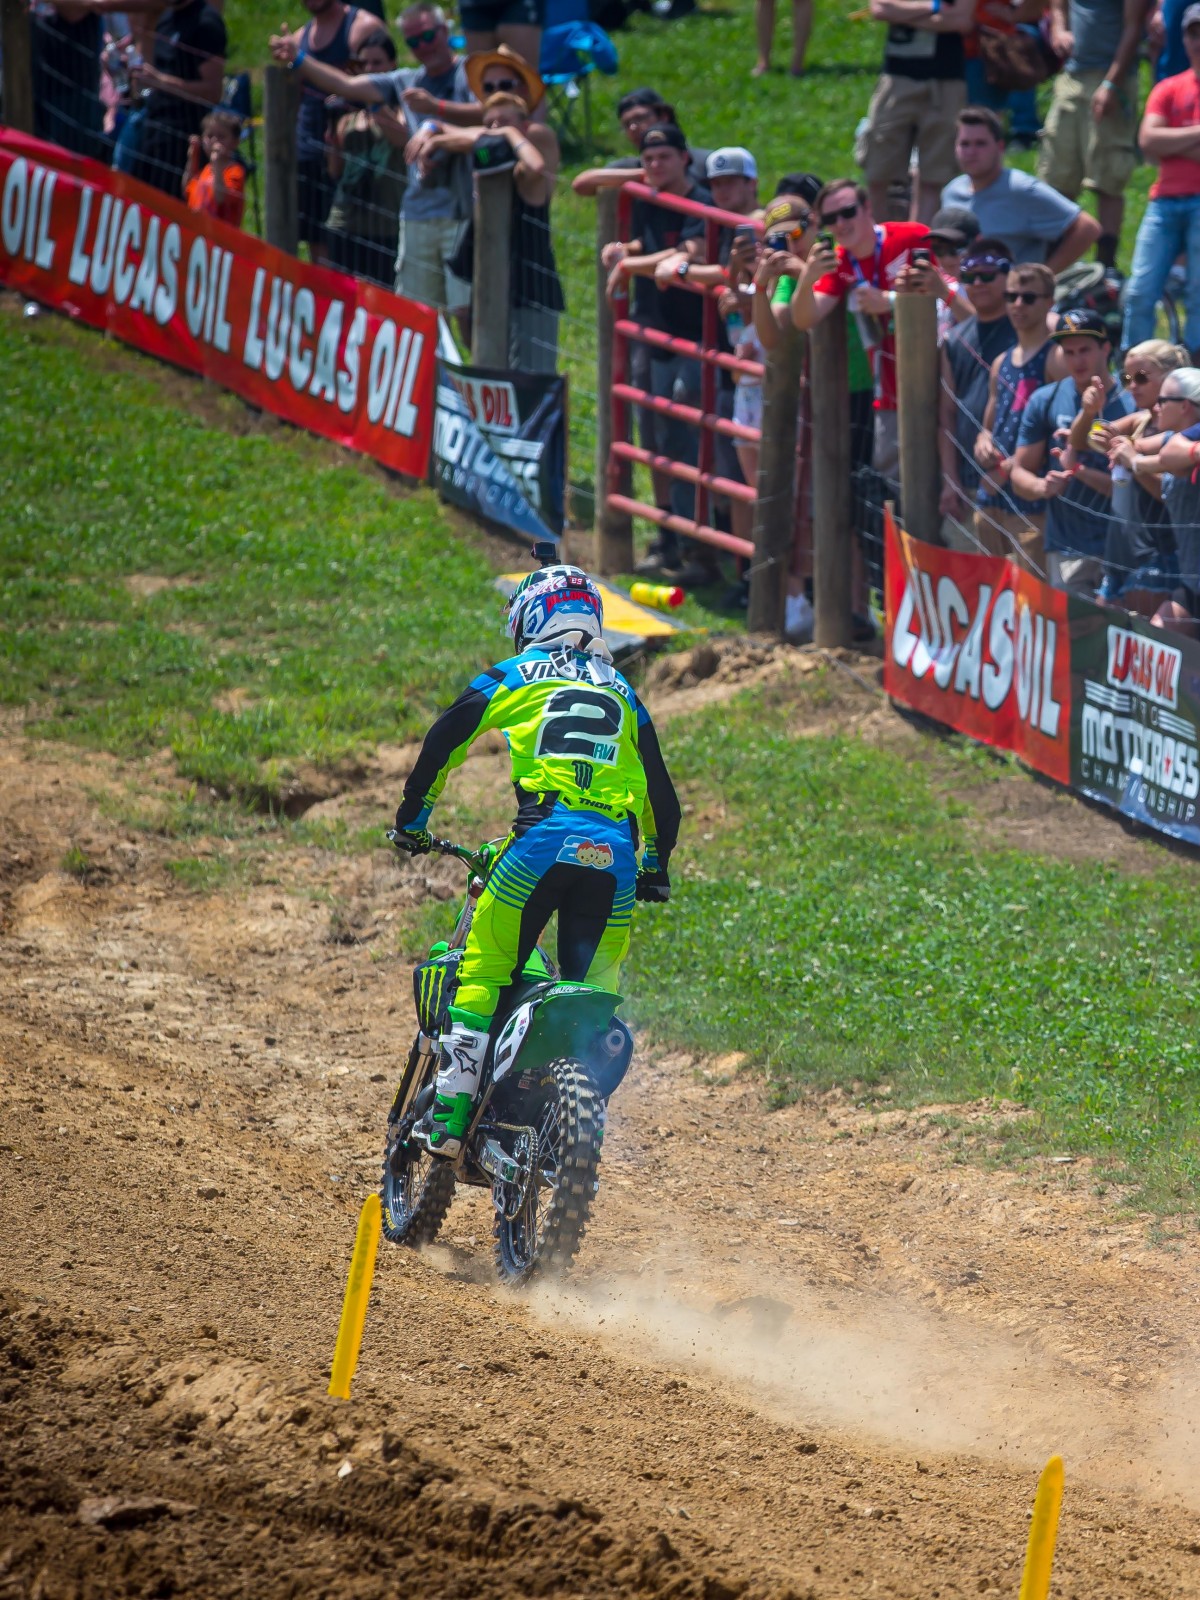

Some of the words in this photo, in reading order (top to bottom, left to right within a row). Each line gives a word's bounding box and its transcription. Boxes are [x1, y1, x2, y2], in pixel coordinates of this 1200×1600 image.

[2, 156, 58, 270] OIL
[68, 186, 181, 325] LUCAS
[185, 235, 234, 353] OIL
[243, 267, 368, 413] LUCAS
[366, 317, 424, 437] OIL
[893, 568, 1015, 710] LUCAS
[1016, 602, 1062, 739] OIL
[1111, 632, 1154, 692] LUCAS
[1155, 649, 1178, 702] OIL
[538, 688, 624, 757] 2
[578, 796, 614, 812] THOR
